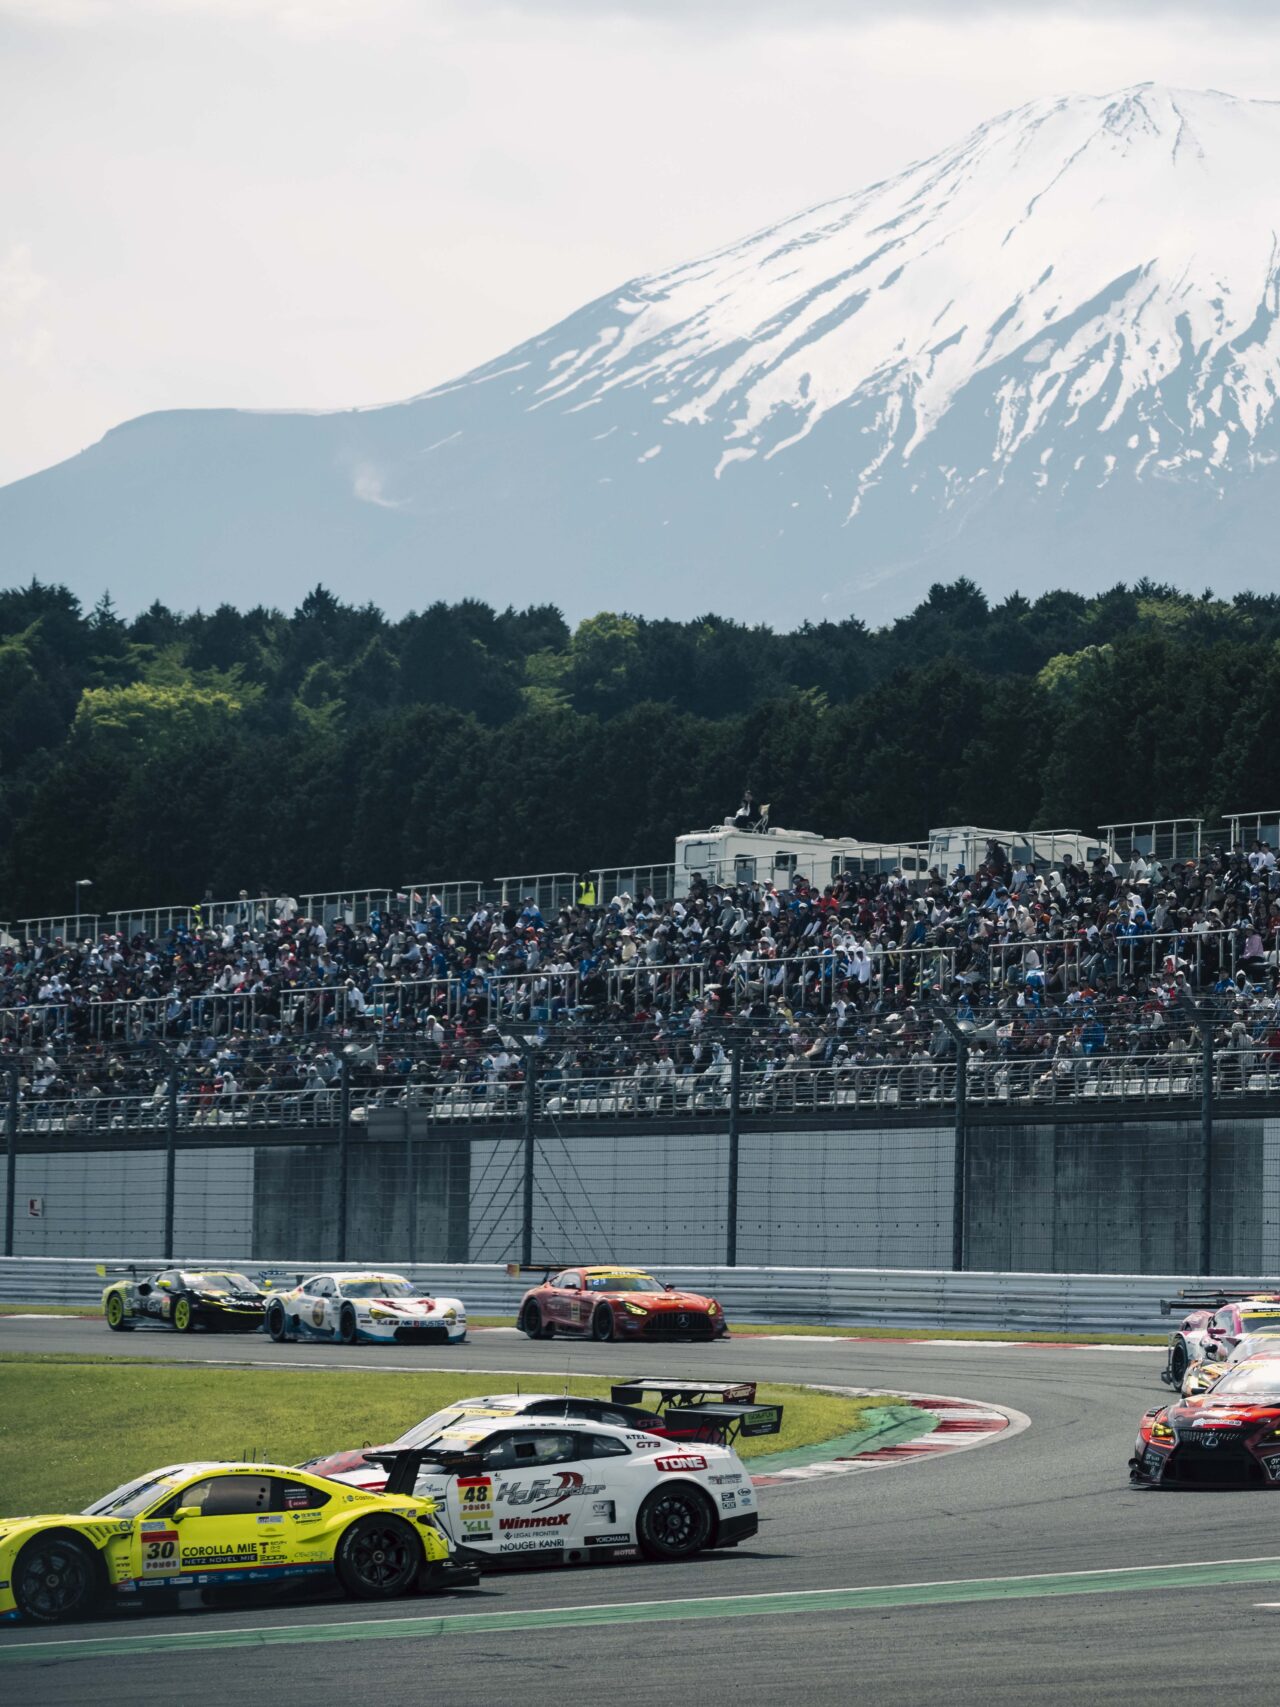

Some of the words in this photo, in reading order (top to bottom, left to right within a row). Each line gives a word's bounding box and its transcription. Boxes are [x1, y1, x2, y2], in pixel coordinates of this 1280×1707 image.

[636, 1441, 661, 1449] GT3
[658, 1457, 704, 1470] TONE
[464, 1486, 488, 1502] 48
[463, 1503, 490, 1511] PONOS
[513, 1531, 531, 1539] LEGAL
[595, 1535, 629, 1544] YOKOHAMA
[146, 1541, 175, 1560] 30
[182, 1544, 234, 1557] COROLLA
[237, 1542, 257, 1554] MIE
[500, 1541, 536, 1552] NOUGEI
[539, 1539, 565, 1548] KANRI
[146, 1560, 177, 1570] PONOS
[184, 1558, 207, 1566] NETZ
[209, 1556, 238, 1564] NOVEL
[240, 1554, 256, 1562] MIE
